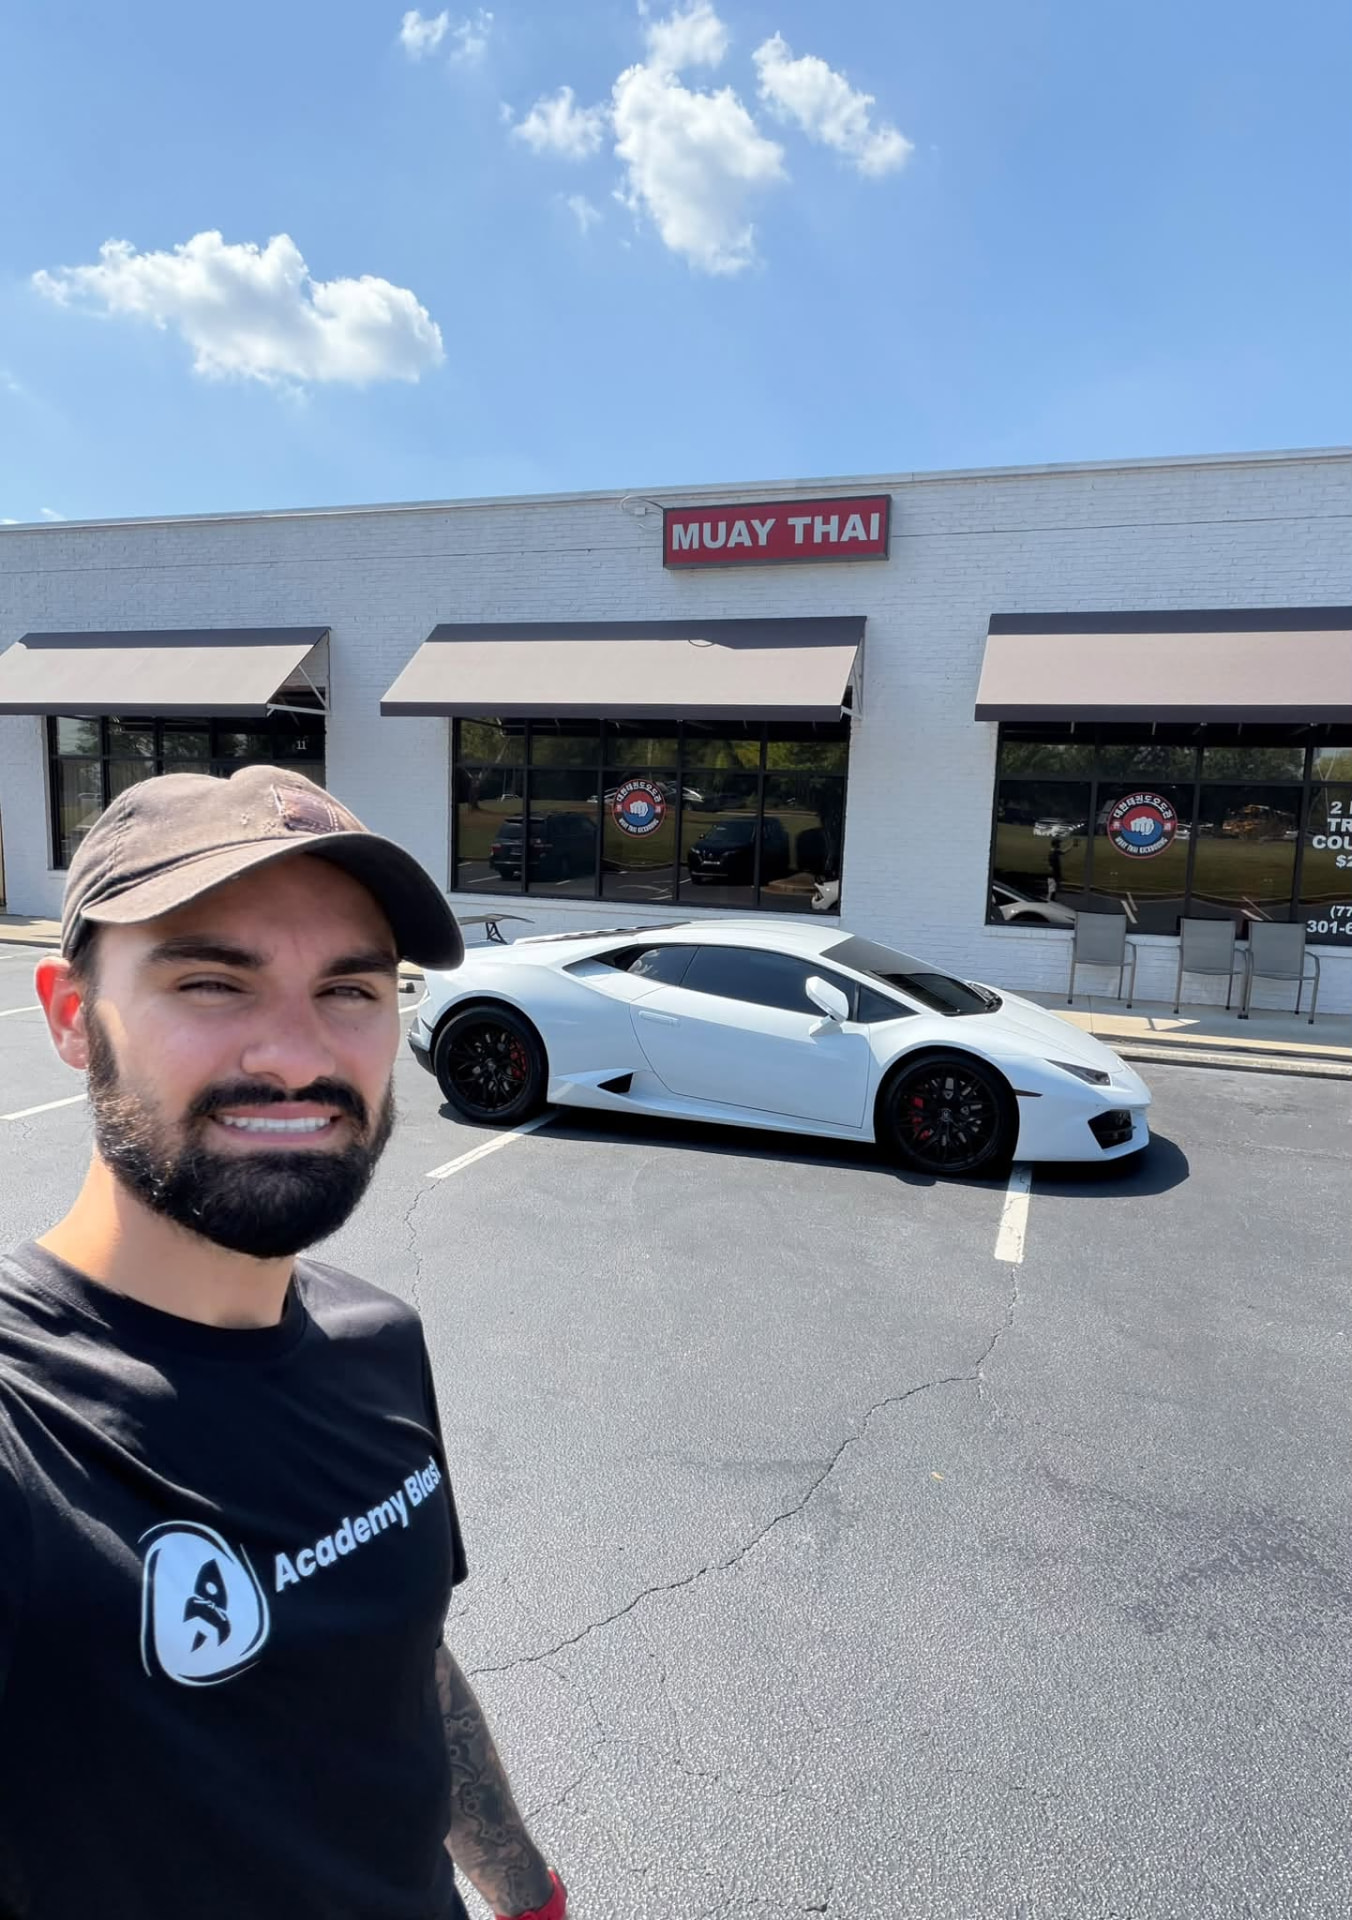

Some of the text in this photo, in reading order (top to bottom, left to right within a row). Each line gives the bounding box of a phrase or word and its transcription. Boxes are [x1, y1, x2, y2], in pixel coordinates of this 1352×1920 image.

[672, 513, 880, 550] MUAY THAI
[1330, 801, 1342, 814] 2
[274, 1489, 410, 1592] Academy
